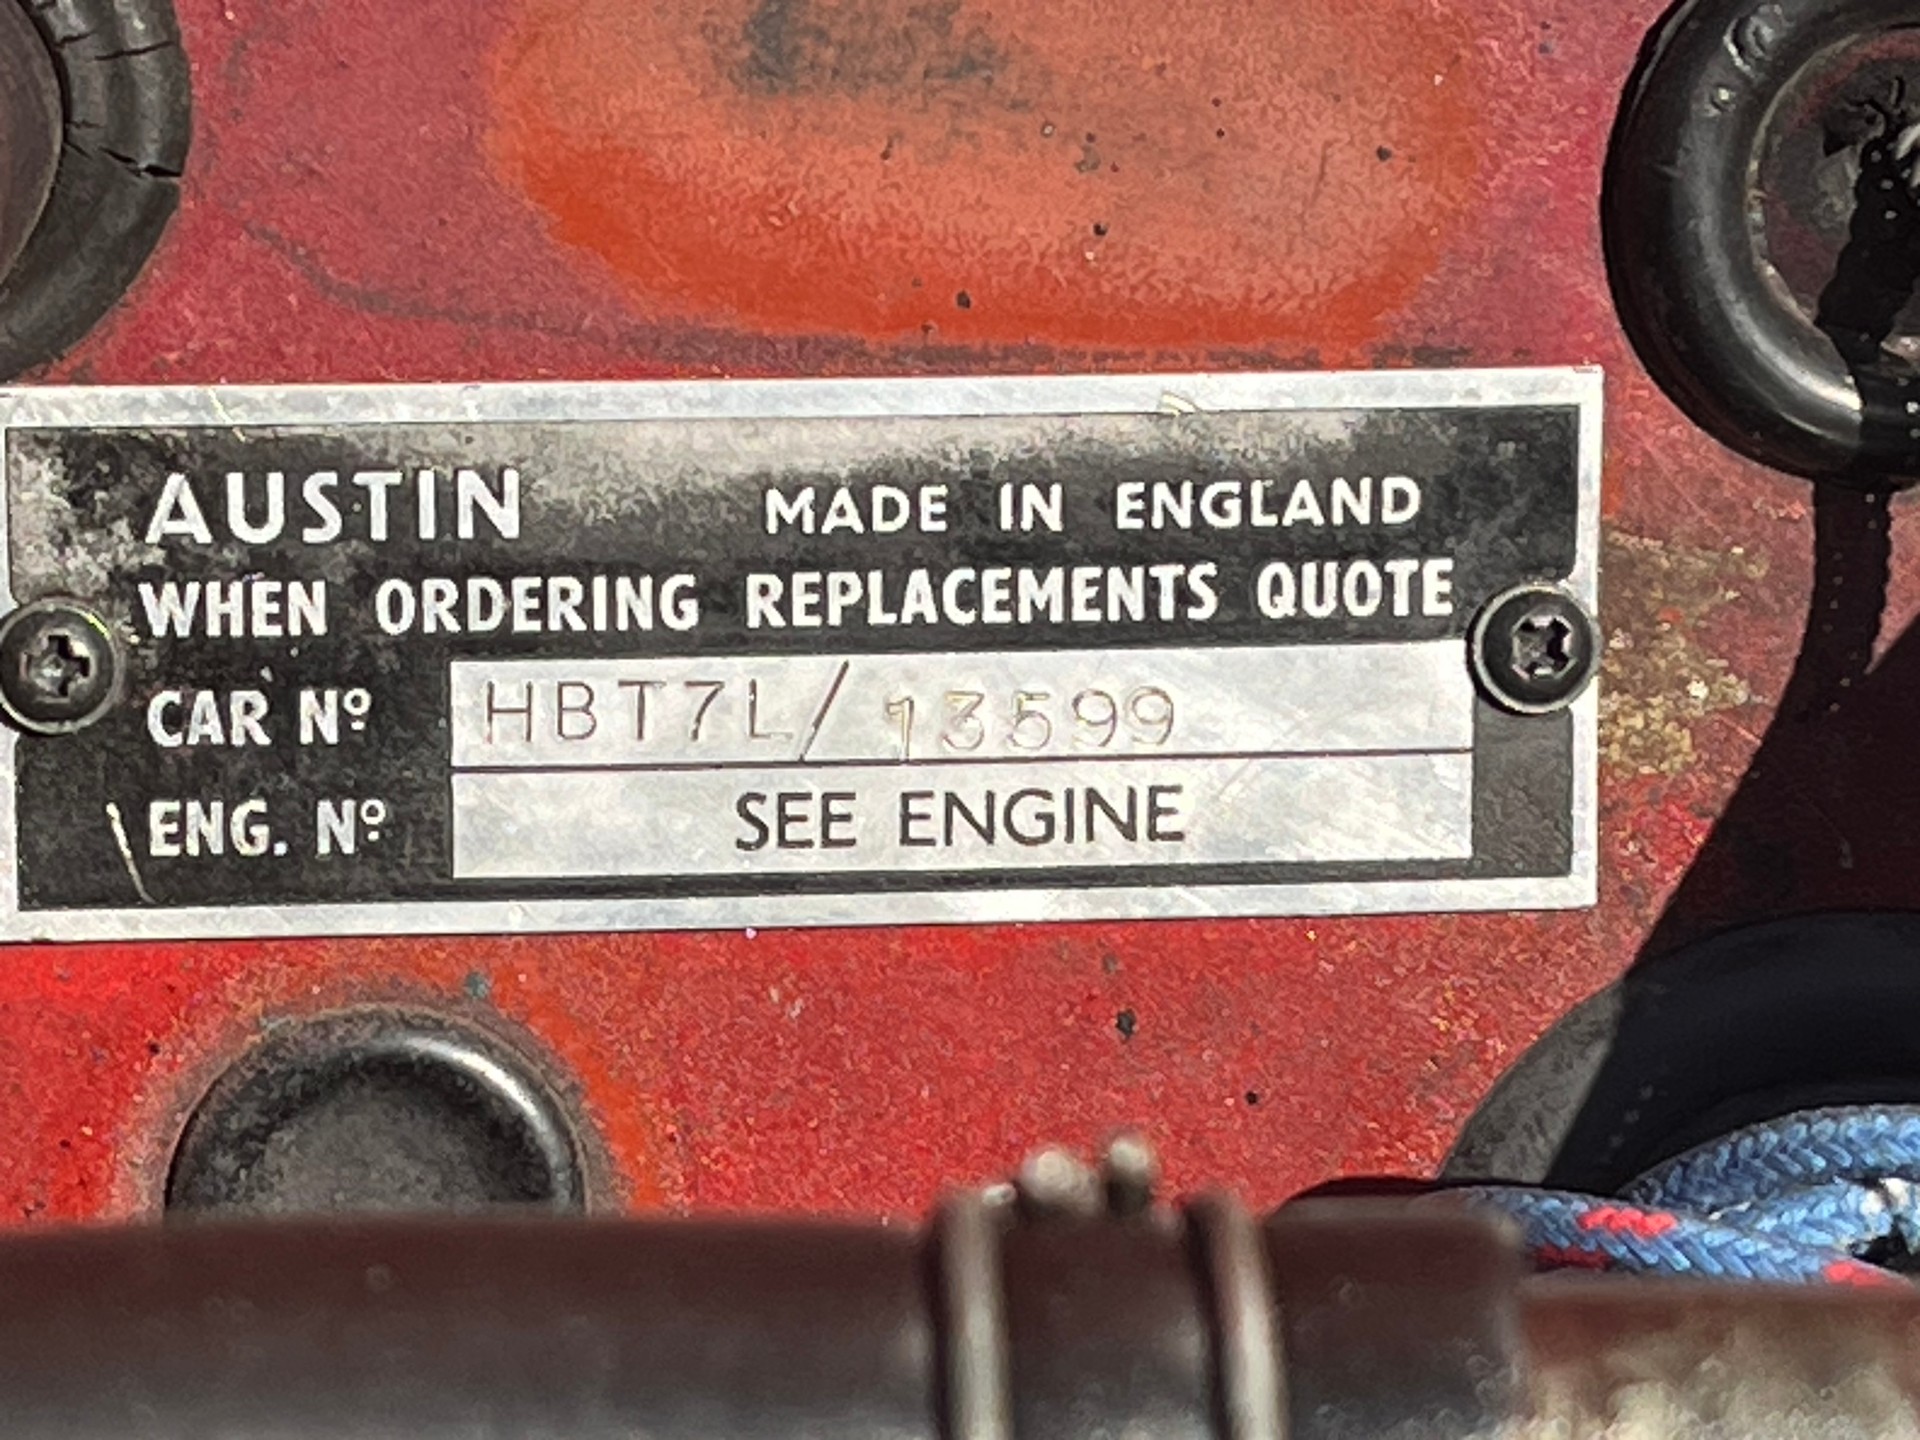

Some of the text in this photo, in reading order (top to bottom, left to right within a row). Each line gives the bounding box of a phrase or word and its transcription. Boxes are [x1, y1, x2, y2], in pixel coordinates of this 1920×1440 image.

[145, 468, 520, 544] AUSTIN
[765, 477, 1421, 535] MADE IN ENGLAND
[138, 557, 1454, 638] WHEN ORDERING REPLACEMENTS QUOTE
[147, 689, 271, 747] CAR
[149, 799, 288, 858] ENG.
[735, 784, 1187, 851] SEE ENGINE
